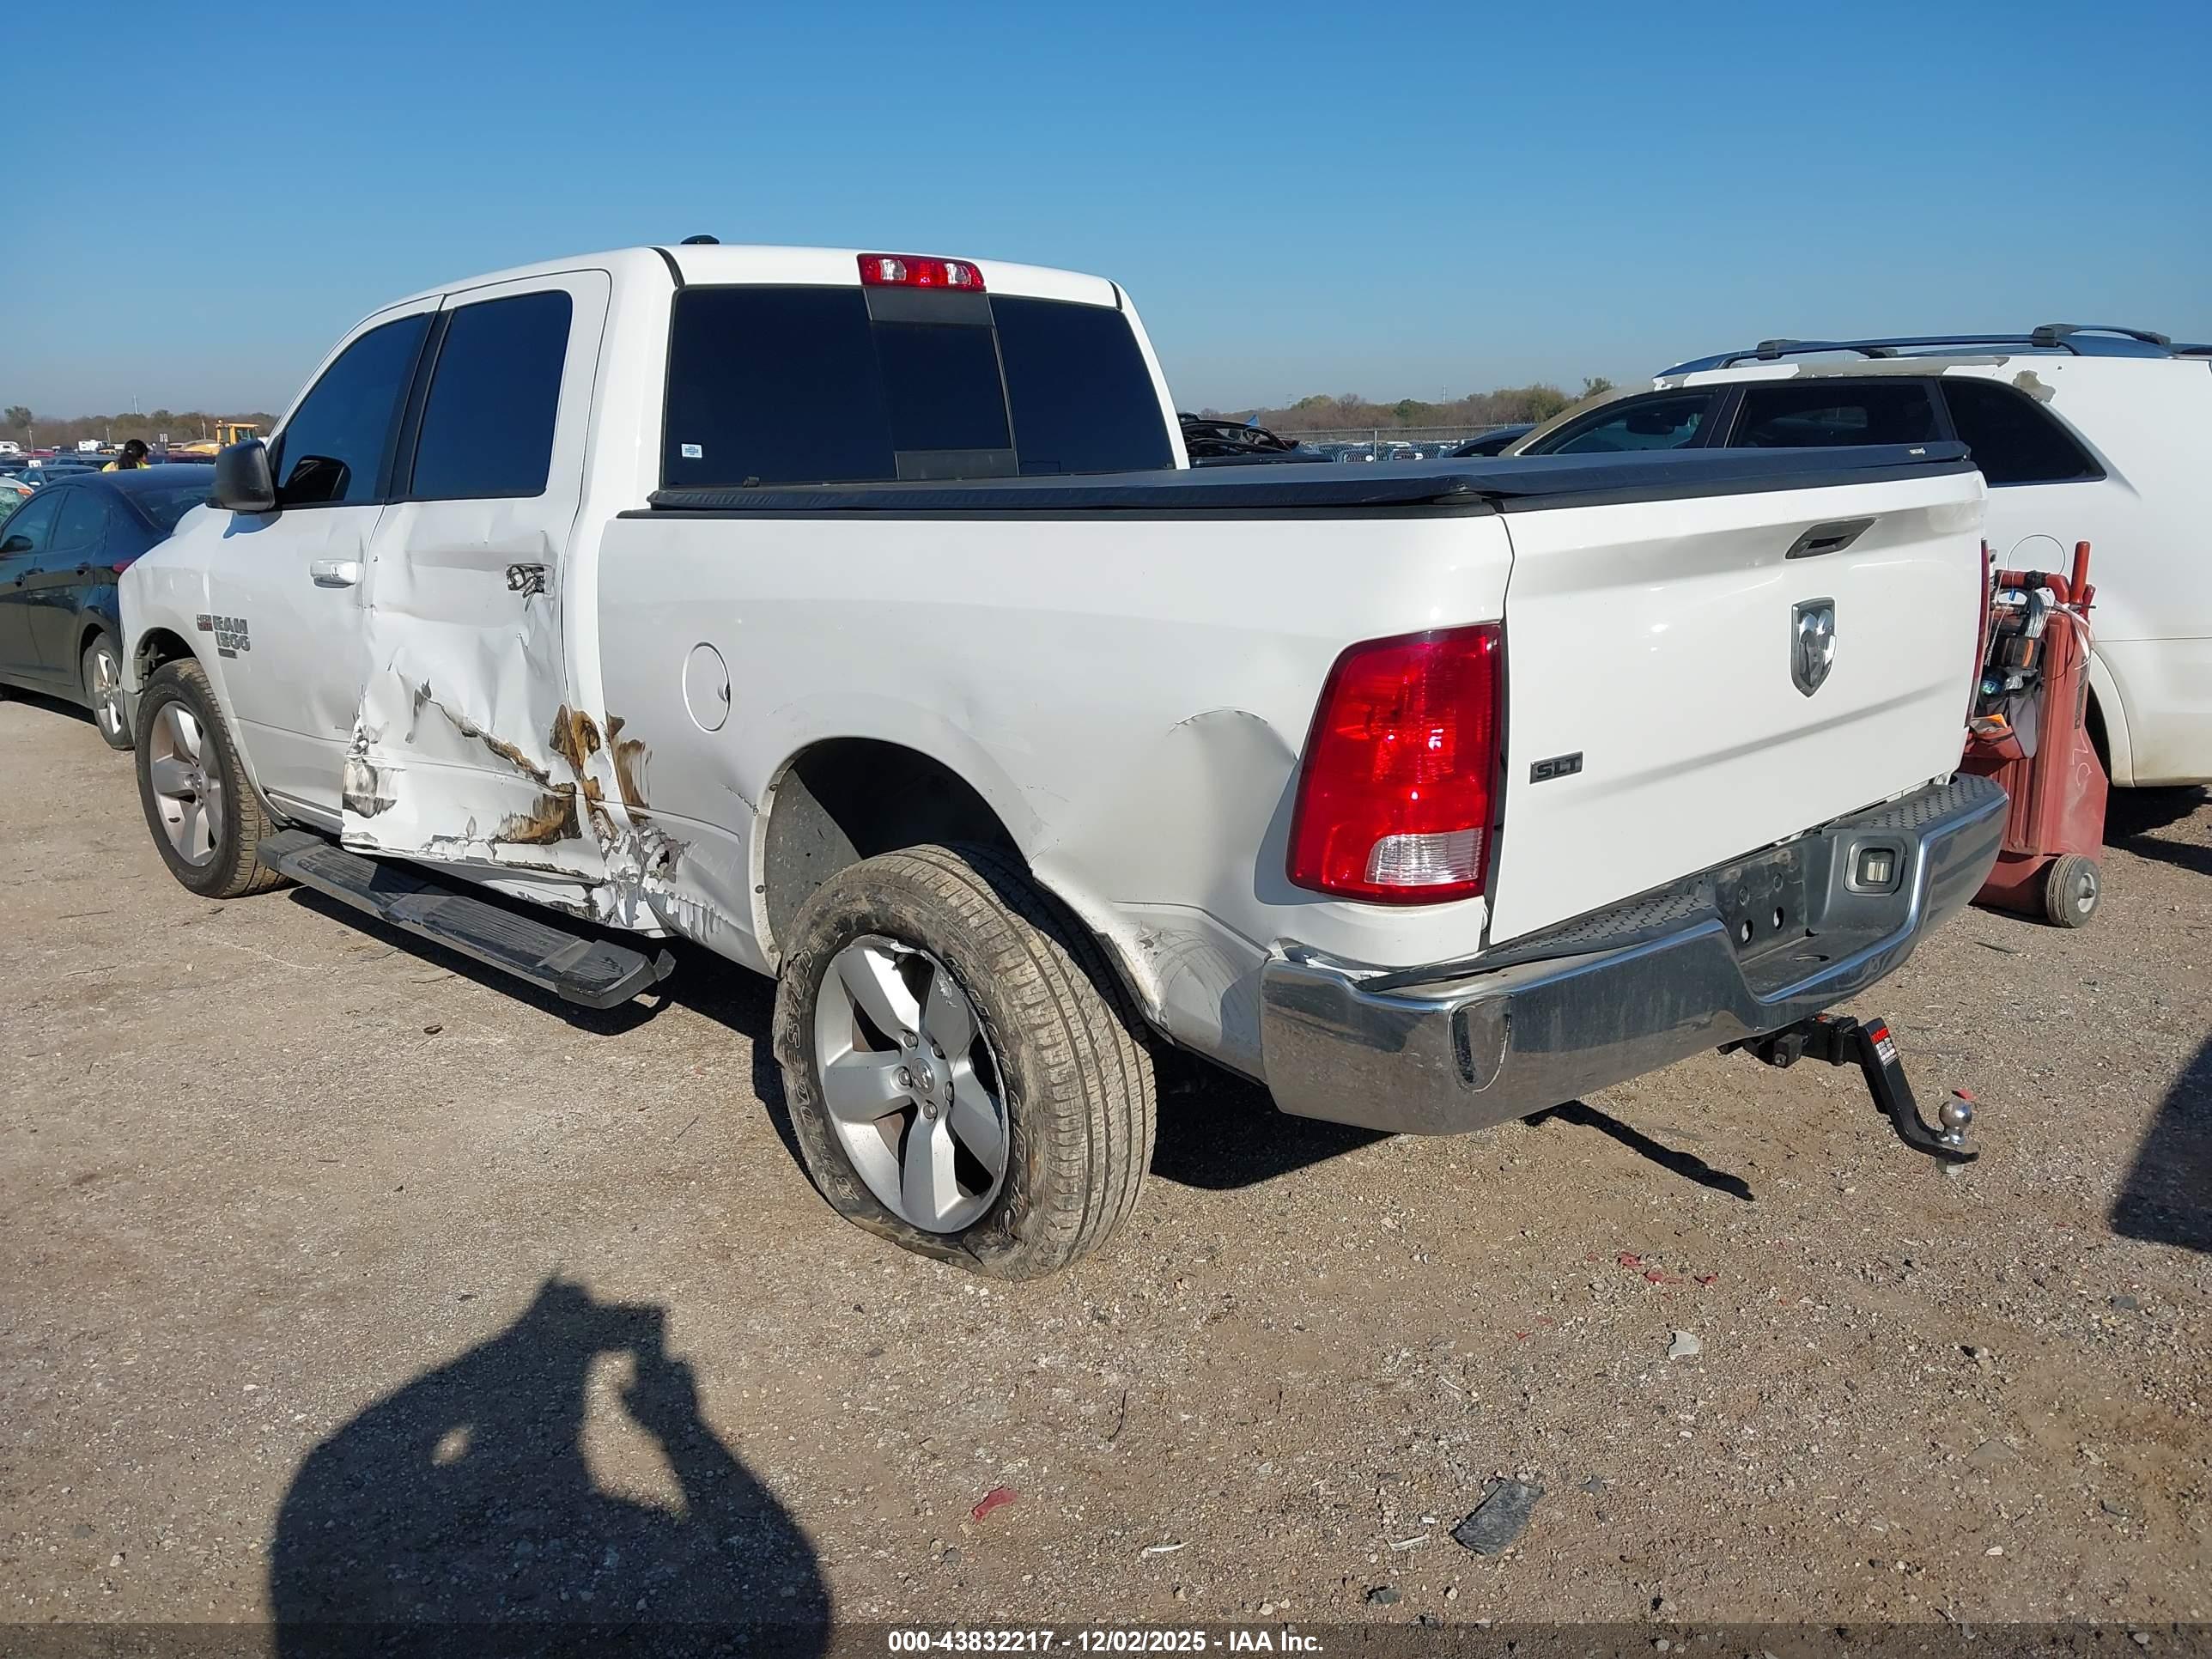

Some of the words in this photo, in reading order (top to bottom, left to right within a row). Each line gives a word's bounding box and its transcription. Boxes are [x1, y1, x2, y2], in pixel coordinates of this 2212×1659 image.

[212, 615, 249, 635] RAM
[214, 630, 251, 652] 1500
[1534, 756, 1582, 781] SLT
